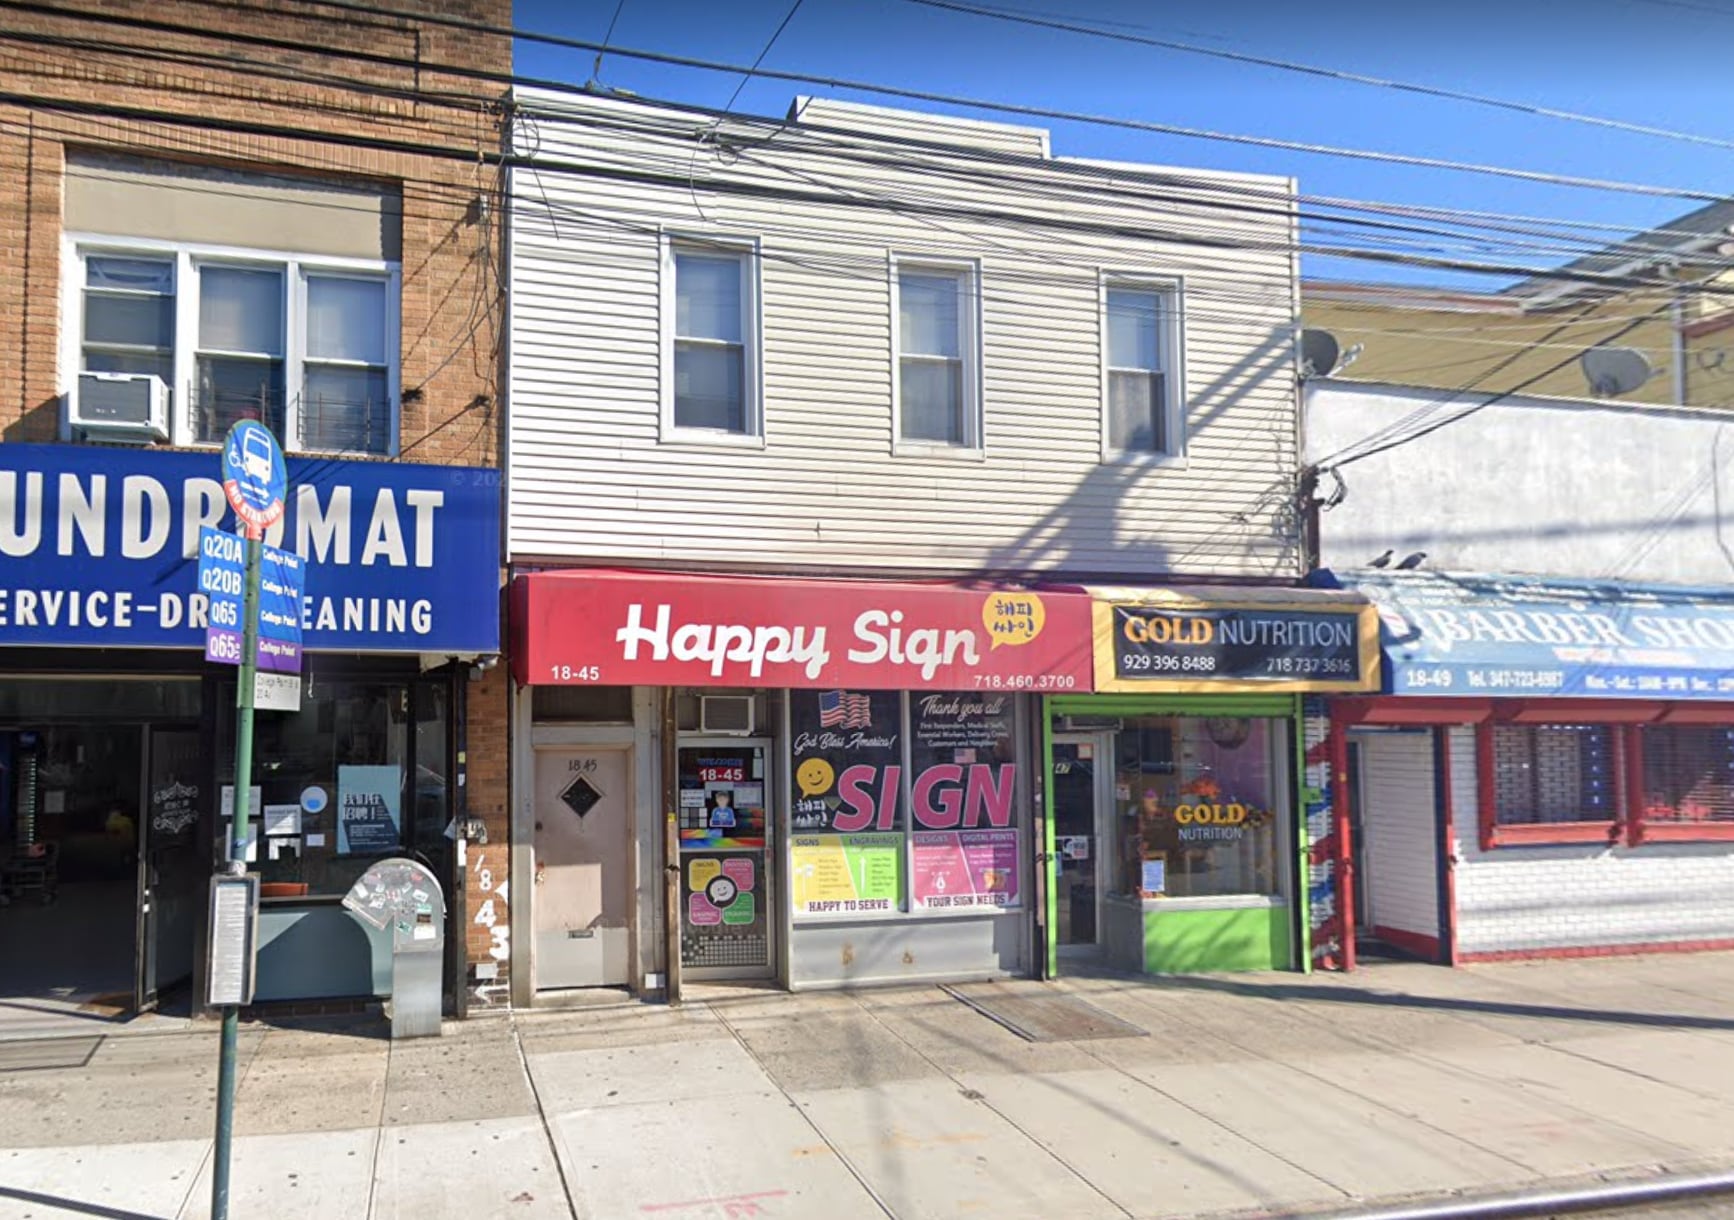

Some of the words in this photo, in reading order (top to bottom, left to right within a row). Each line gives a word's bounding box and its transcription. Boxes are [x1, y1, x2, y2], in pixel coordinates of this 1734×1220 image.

[203, 534, 243, 564] Q20A
[202, 567, 242, 596] Q20B
[211, 600, 237, 626] Q65
[994, 599, 1033, 617] 해피
[1123, 617, 1214, 645] GOLD
[1219, 619, 1352, 647] NUTRITION
[1423, 609, 1638, 648] BARBER
[210, 633, 236, 660] Q65
[615, 603, 830, 681] Happy
[847, 609, 981, 682] Sign
[1123, 655, 1151, 670] 929
[1153, 655, 1180, 671] 396
[1181, 656, 1216, 671] 8488
[1266, 657, 1293, 672] 718
[1295, 658, 1319, 673] 737
[550, 666, 600, 681] 18-45
[973, 675, 1075, 689] 718.460.3700
[1406, 669, 1453, 688] 18-49
[920, 694, 960, 718] Thank
[957, 703, 983, 722] you
[985, 696, 1006, 714] all
[794, 731, 818, 756] God
[818, 731, 845, 750] Bless
[844, 731, 898, 750] America!
[699, 767, 743, 781] 18-45
[1174, 803, 1248, 825] GOLD
[796, 838, 820, 847] SIGNS
[1178, 827, 1243, 841] NUTRITION
[808, 900, 842, 912] HAPPY
[844, 900, 857, 911] TO
[858, 898, 889, 910] SERVE
[926, 895, 952, 908] YOUR
[953, 895, 974, 907] SIGN
[976, 894, 1006, 906] NEEDS
